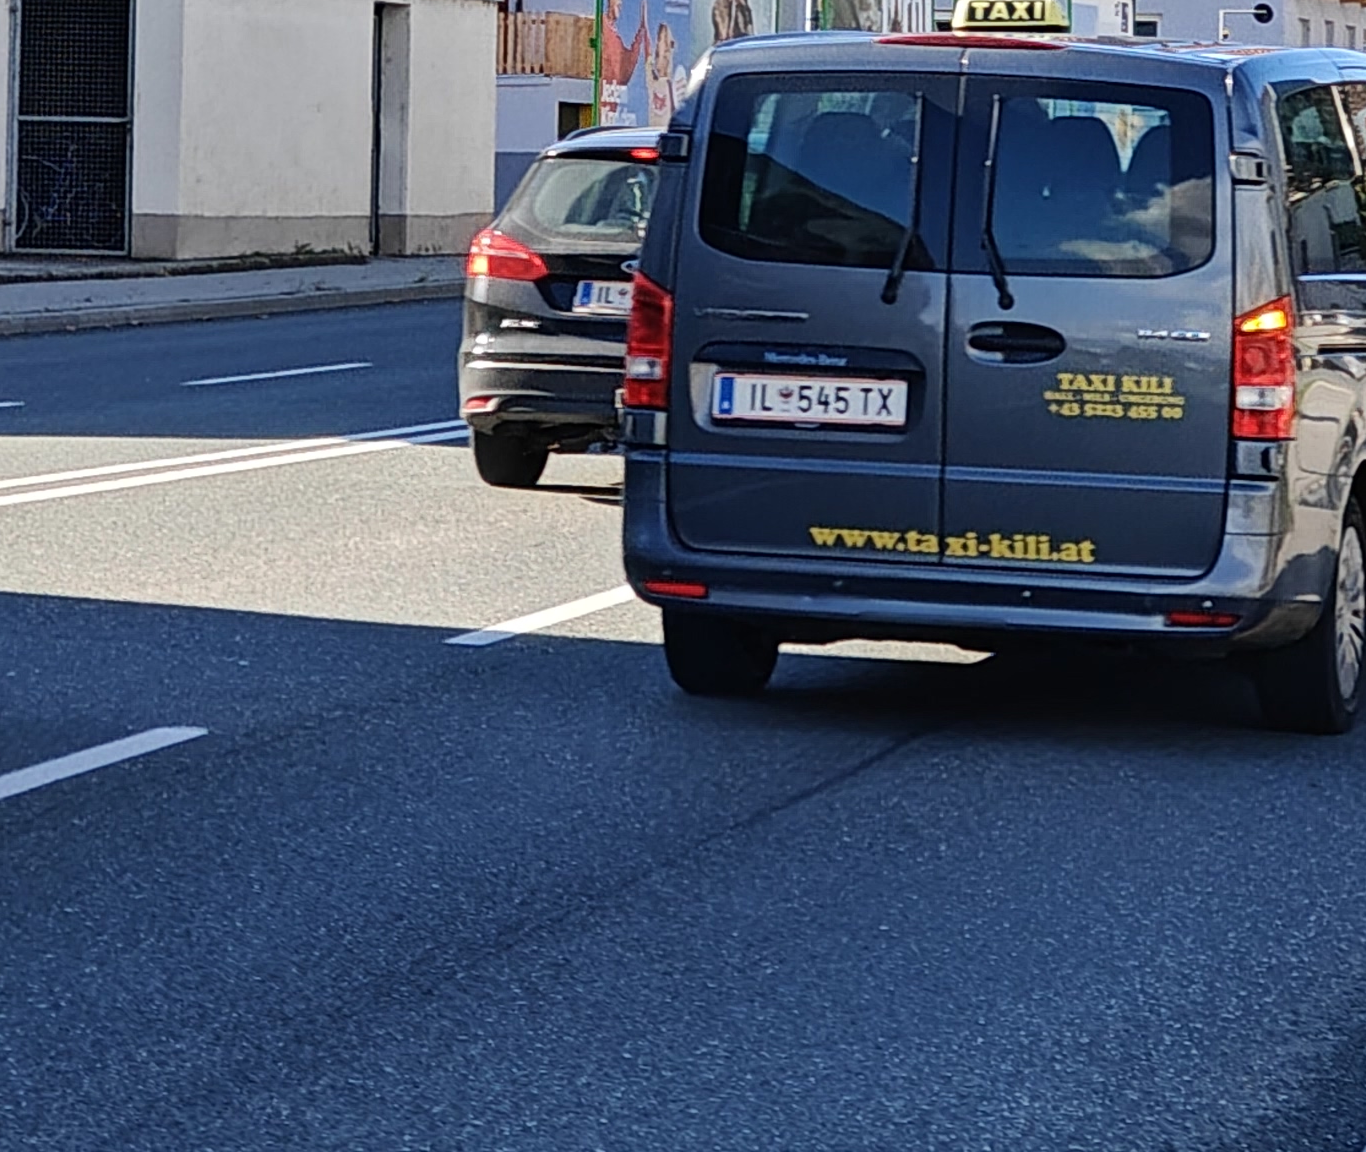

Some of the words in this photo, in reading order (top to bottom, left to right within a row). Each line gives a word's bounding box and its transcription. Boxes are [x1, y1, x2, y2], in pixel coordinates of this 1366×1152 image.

[971, 1, 1044, 21] TAXI
[598, 286, 615, 304] IL
[1057, 372, 1116, 391] TAXI
[1121, 375, 1174, 394] KILI
[749, 384, 773, 412] IL
[797, 385, 851, 415] 545
[859, 388, 893, 417] TX
[809, 527, 1096, 563] www.taxi-kili.at
